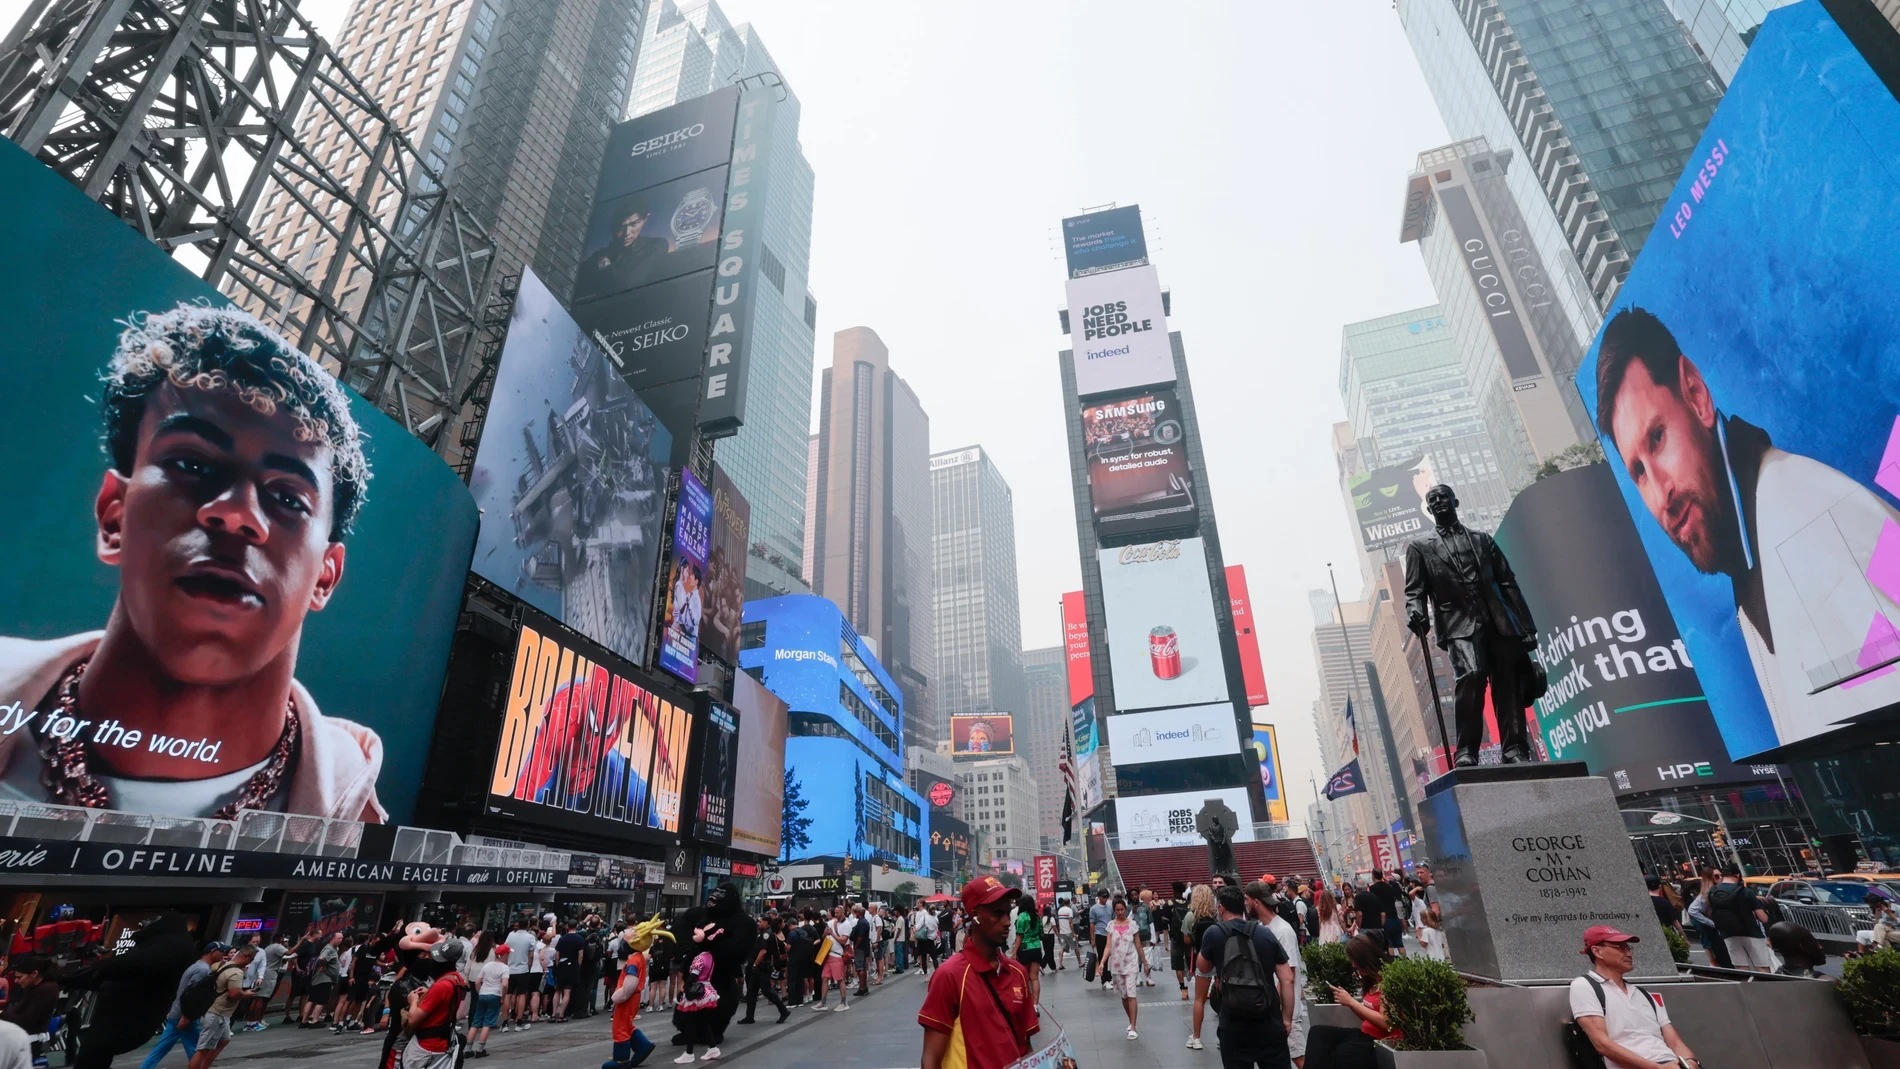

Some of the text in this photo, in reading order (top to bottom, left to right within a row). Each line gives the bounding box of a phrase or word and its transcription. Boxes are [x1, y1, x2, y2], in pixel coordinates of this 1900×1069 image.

[631, 123, 705, 157] SEIKO
[645, 142, 686, 159] SINCE 1881
[728, 101, 760, 211] TIMES
[1670, 138, 1729, 239] LEO MESSI
[1072, 235, 1126, 249] rewards those
[1087, 230, 1114, 240] market
[1091, 241, 1129, 252] challenge
[1464, 238, 1511, 317] GUCCI
[706, 230, 744, 400] SQUARE
[1083, 301, 1127, 318] JOBS
[611, 324, 642, 339] Newest
[643, 316, 674, 330] Classic
[1083, 313, 1128, 330] NEED
[1085, 319, 1153, 341] PEOPLE
[632, 324, 690, 352] SEIKO
[1086, 345, 1130, 360] indeed
[1095, 400, 1165, 420] SAMSUNG
[930, 456, 959, 467] Allianz
[1108, 458, 1168, 472] detailed audio
[1109, 454, 1129, 465] sync
[1130, 451, 1143, 460] for
[1144, 448, 1174, 459] robust,
[681, 504, 708, 537] MAYBE
[714, 487, 747, 539] OUTSIDERS
[680, 516, 708, 546] HAPPY
[1365, 518, 1421, 541] WICKED
[679, 527, 706, 558] ENDING
[1118, 539, 1182, 565] Coca-Cola
[1079, 621, 1087, 629] wi
[667, 627, 680, 641] TONY
[1535, 609, 1646, 674] lf-driving
[665, 644, 676, 657] BEST
[1070, 642, 1087, 651] your
[775, 649, 816, 662] Morgan
[1594, 638, 1693, 681] that
[1538, 658, 1592, 718] network
[491, 625, 610, 814] BRAND
[0, 701, 222, 763] dy for the world.
[1156, 728, 1190, 741] indeed
[1549, 719, 1577, 758] gets
[1574, 701, 1611, 744] you
[595, 673, 660, 826] NEW
[647, 699, 693, 833] DAY
[1614, 770, 1628, 779] HPE
[1657, 762, 1714, 780] HPE
[1752, 767, 1776, 776] NYSE
[708, 794, 726, 808] MAYBE
[708, 804, 726, 816] HAPPY
[1168, 809, 1193, 818] JOBS
[706, 813, 725, 826] ENDING
[1168, 817, 1193, 826] NEED
[1169, 825, 1195, 834] PEOP
[482, 838, 501, 848] SPORTS
[1512, 835, 1585, 852] GEORGE
[0, 844, 48, 867] erie
[103, 849, 235, 873] OFFLINE
[292, 860, 394, 880] AMERICAN
[402, 867, 449, 882] EAGLE
[506, 871, 554, 884] OFFLINE
[706, 855, 731, 869] BLUE FIN
[1546, 853, 1563, 866] M
[1040, 858, 1054, 889] tkts
[1526, 867, 1591, 882] COHAN
[671, 881, 689, 890] HEYTEA
[798, 878, 839, 890] KLIKTIX
[1539, 887, 1588, 899] 1878-1942
[1512, 911, 1631, 925] Give my Regards to Broadway
